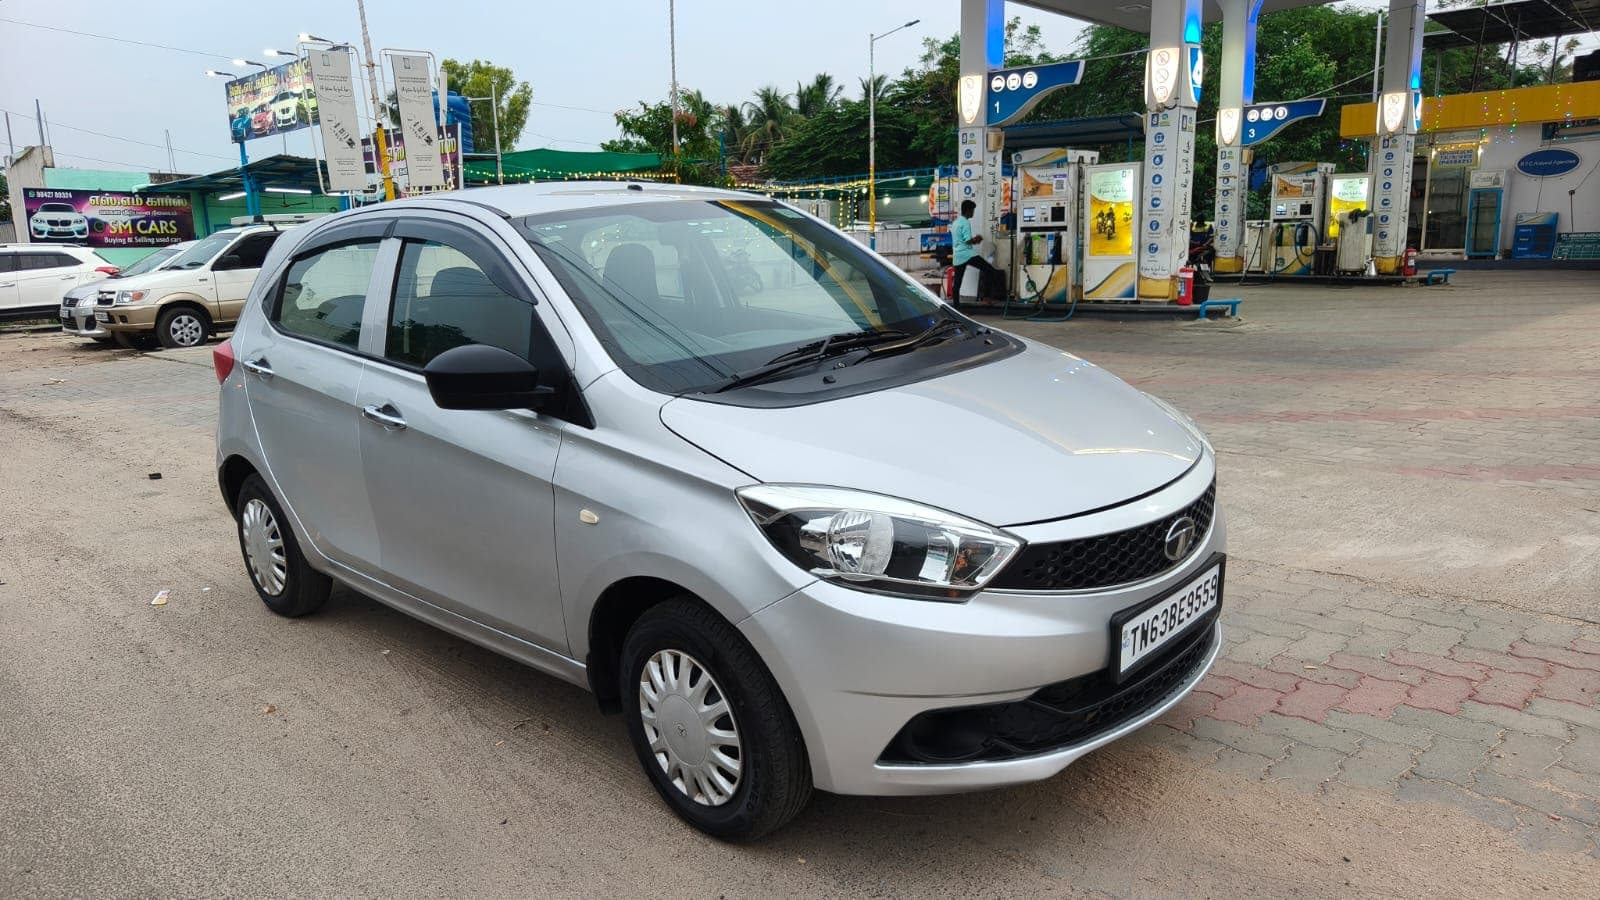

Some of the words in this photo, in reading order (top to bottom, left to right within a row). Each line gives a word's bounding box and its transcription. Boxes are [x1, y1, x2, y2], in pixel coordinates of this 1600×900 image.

[994, 101, 1000, 114] 1
[1248, 128, 1256, 138] 3
[109, 220, 133, 234] SM
[136, 220, 178, 234] CARS
[104, 237, 127, 245] Buying
[1131, 574, 1218, 657] TN63BE9559
